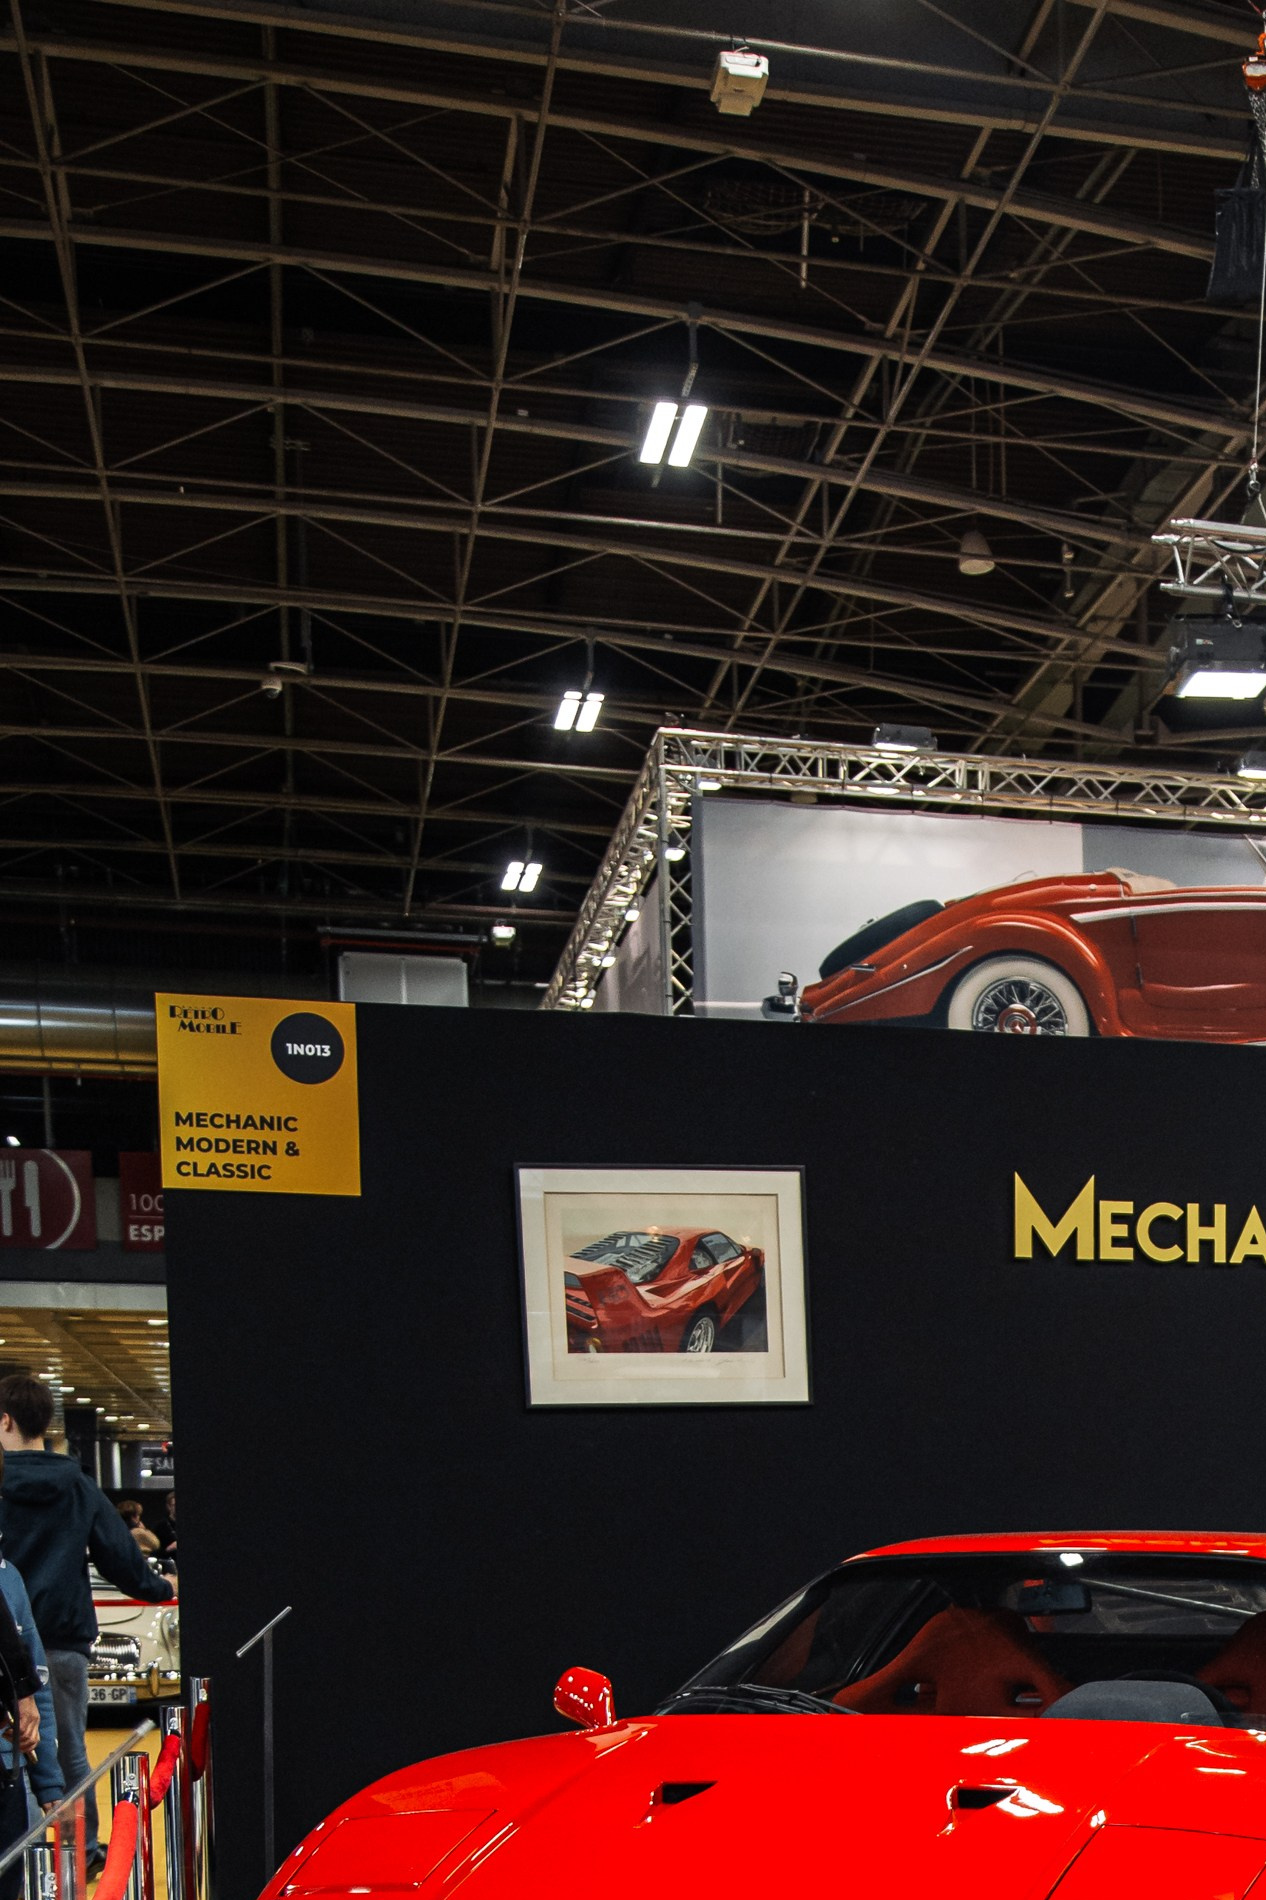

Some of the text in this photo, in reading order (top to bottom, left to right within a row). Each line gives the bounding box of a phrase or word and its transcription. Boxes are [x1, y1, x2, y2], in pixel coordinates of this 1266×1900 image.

[286, 1042, 331, 1057] 1N013
[174, 1111, 299, 1132] MECHANIC
[175, 1136, 300, 1157] MODERN &
[175, 1160, 272, 1180] CLASSIC
